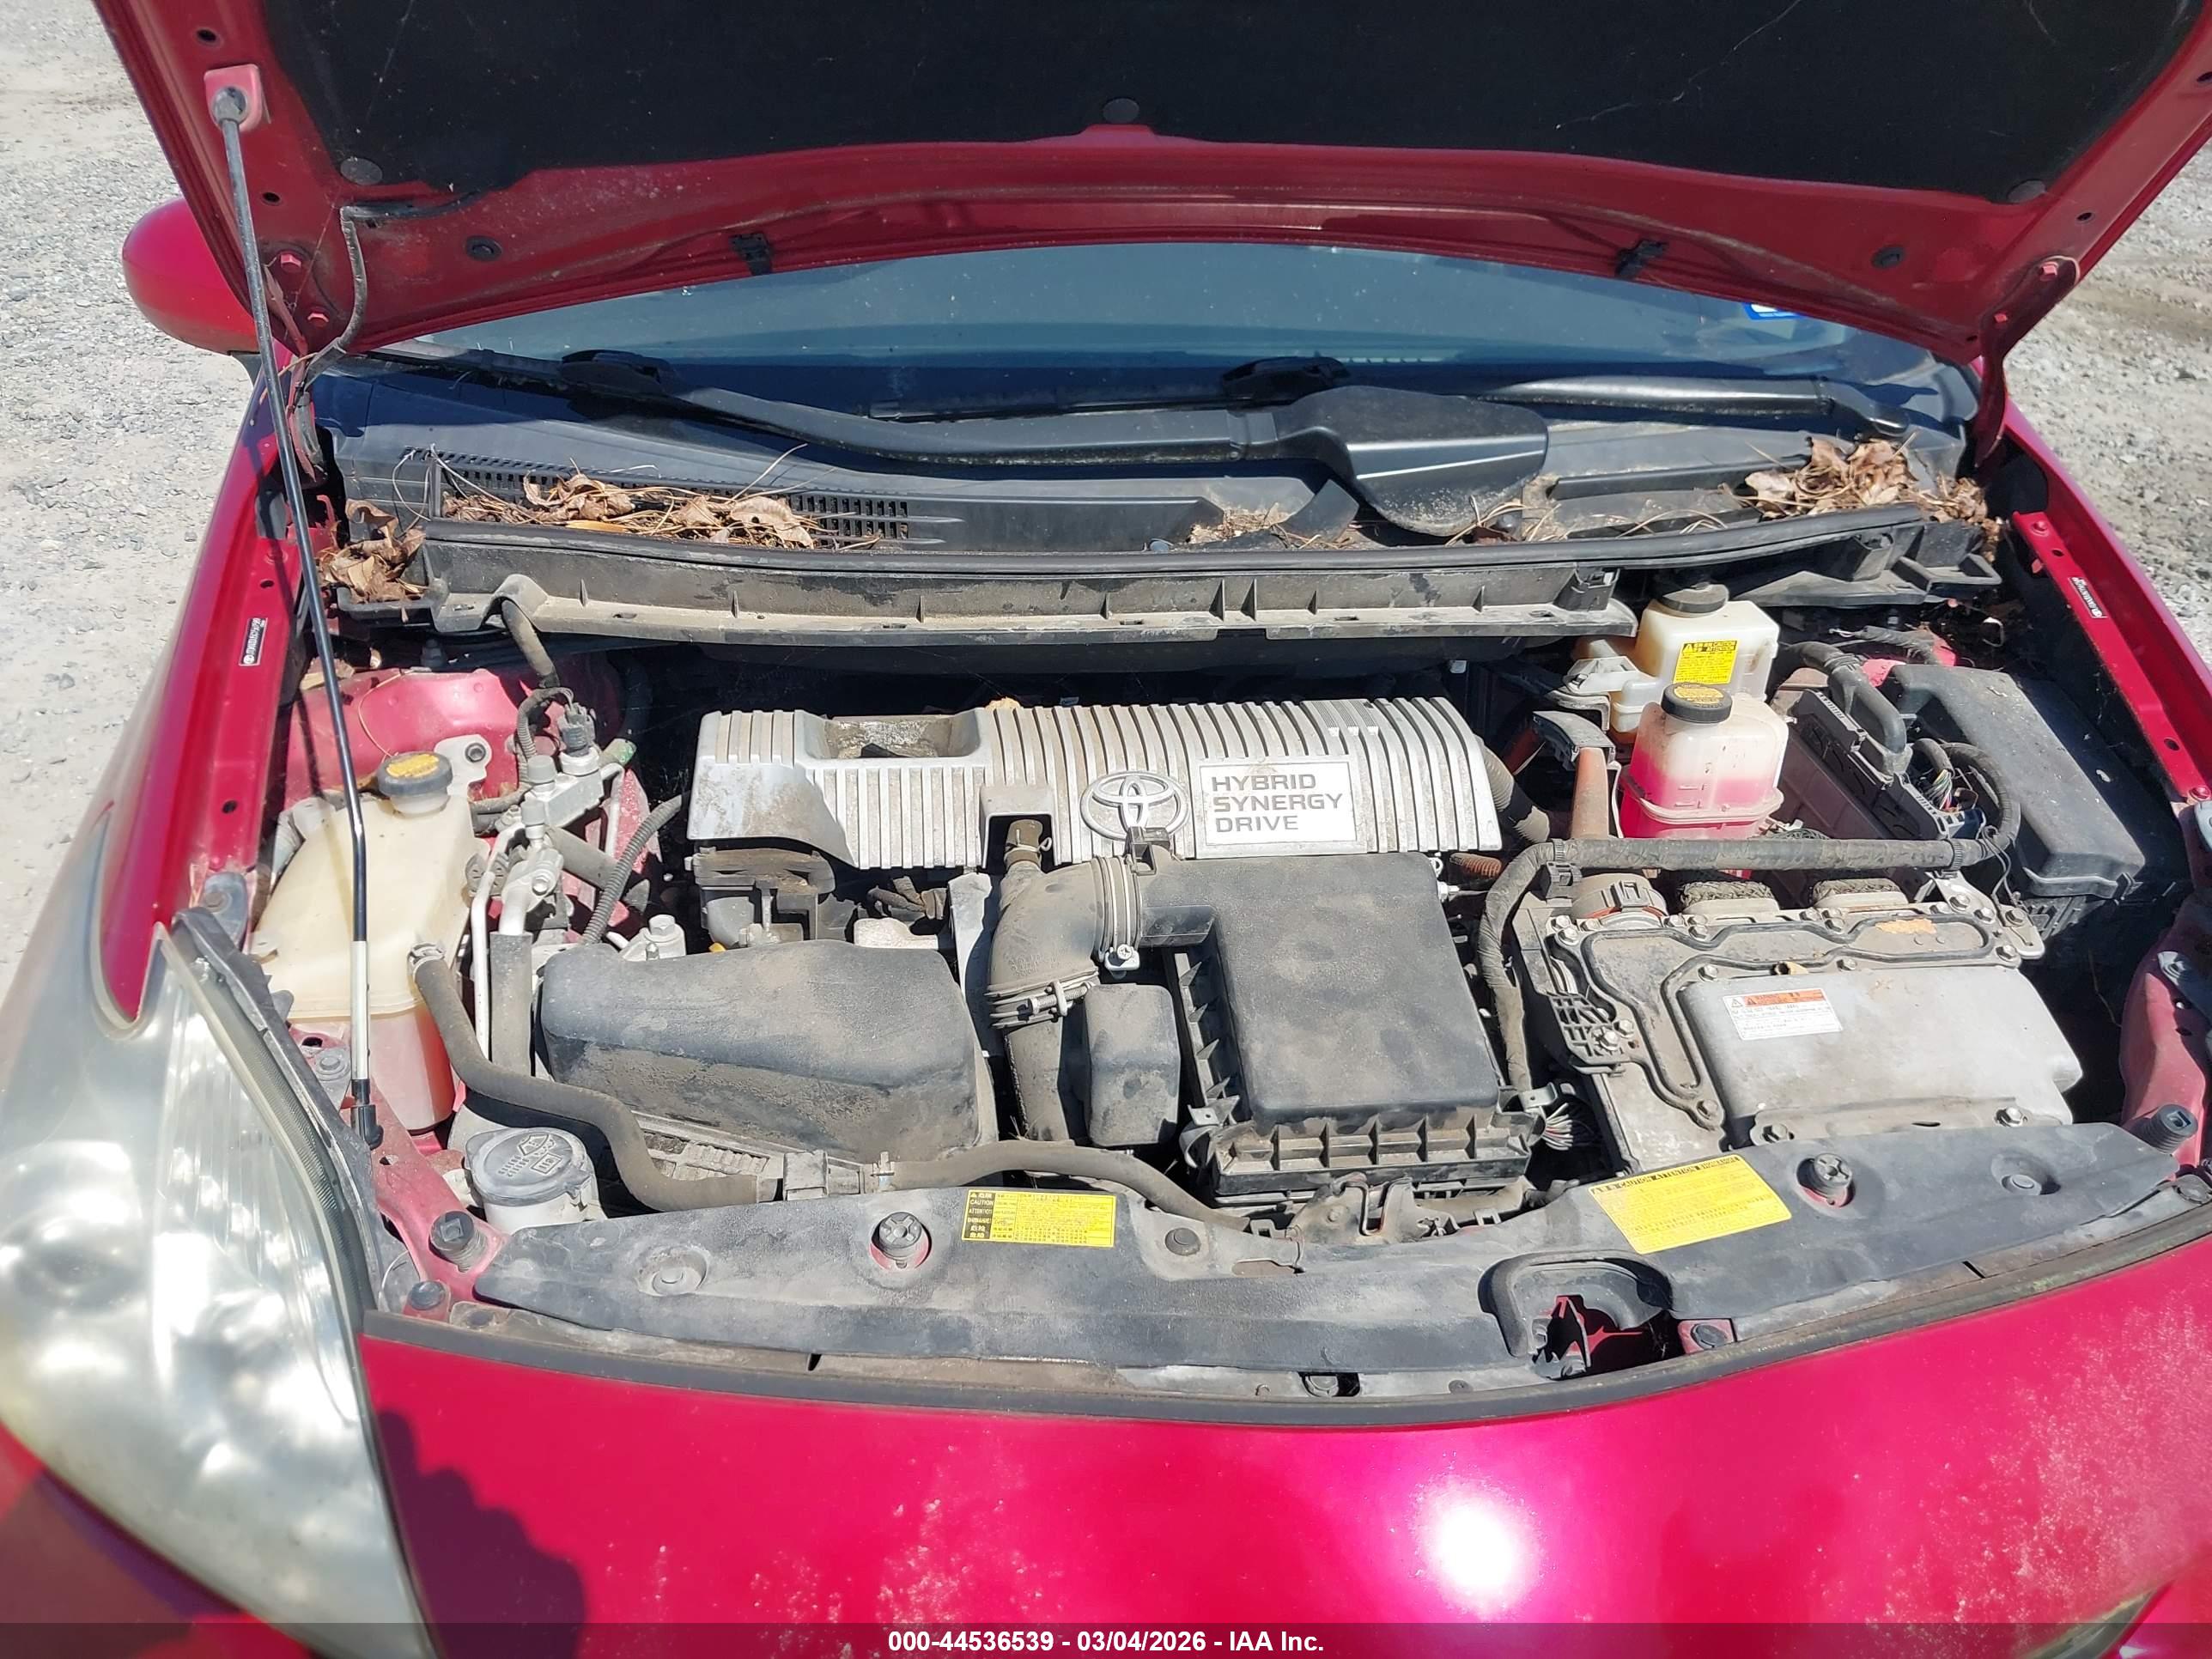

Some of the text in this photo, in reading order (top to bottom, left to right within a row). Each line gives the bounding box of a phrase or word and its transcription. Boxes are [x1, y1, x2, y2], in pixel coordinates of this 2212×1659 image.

[1212, 773, 1316, 792] HYBRID
[1212, 793, 1344, 812] SYNERGY
[1215, 815, 1299, 833] DRIVE
[1620, 1175, 1650, 1189] CAUTION
